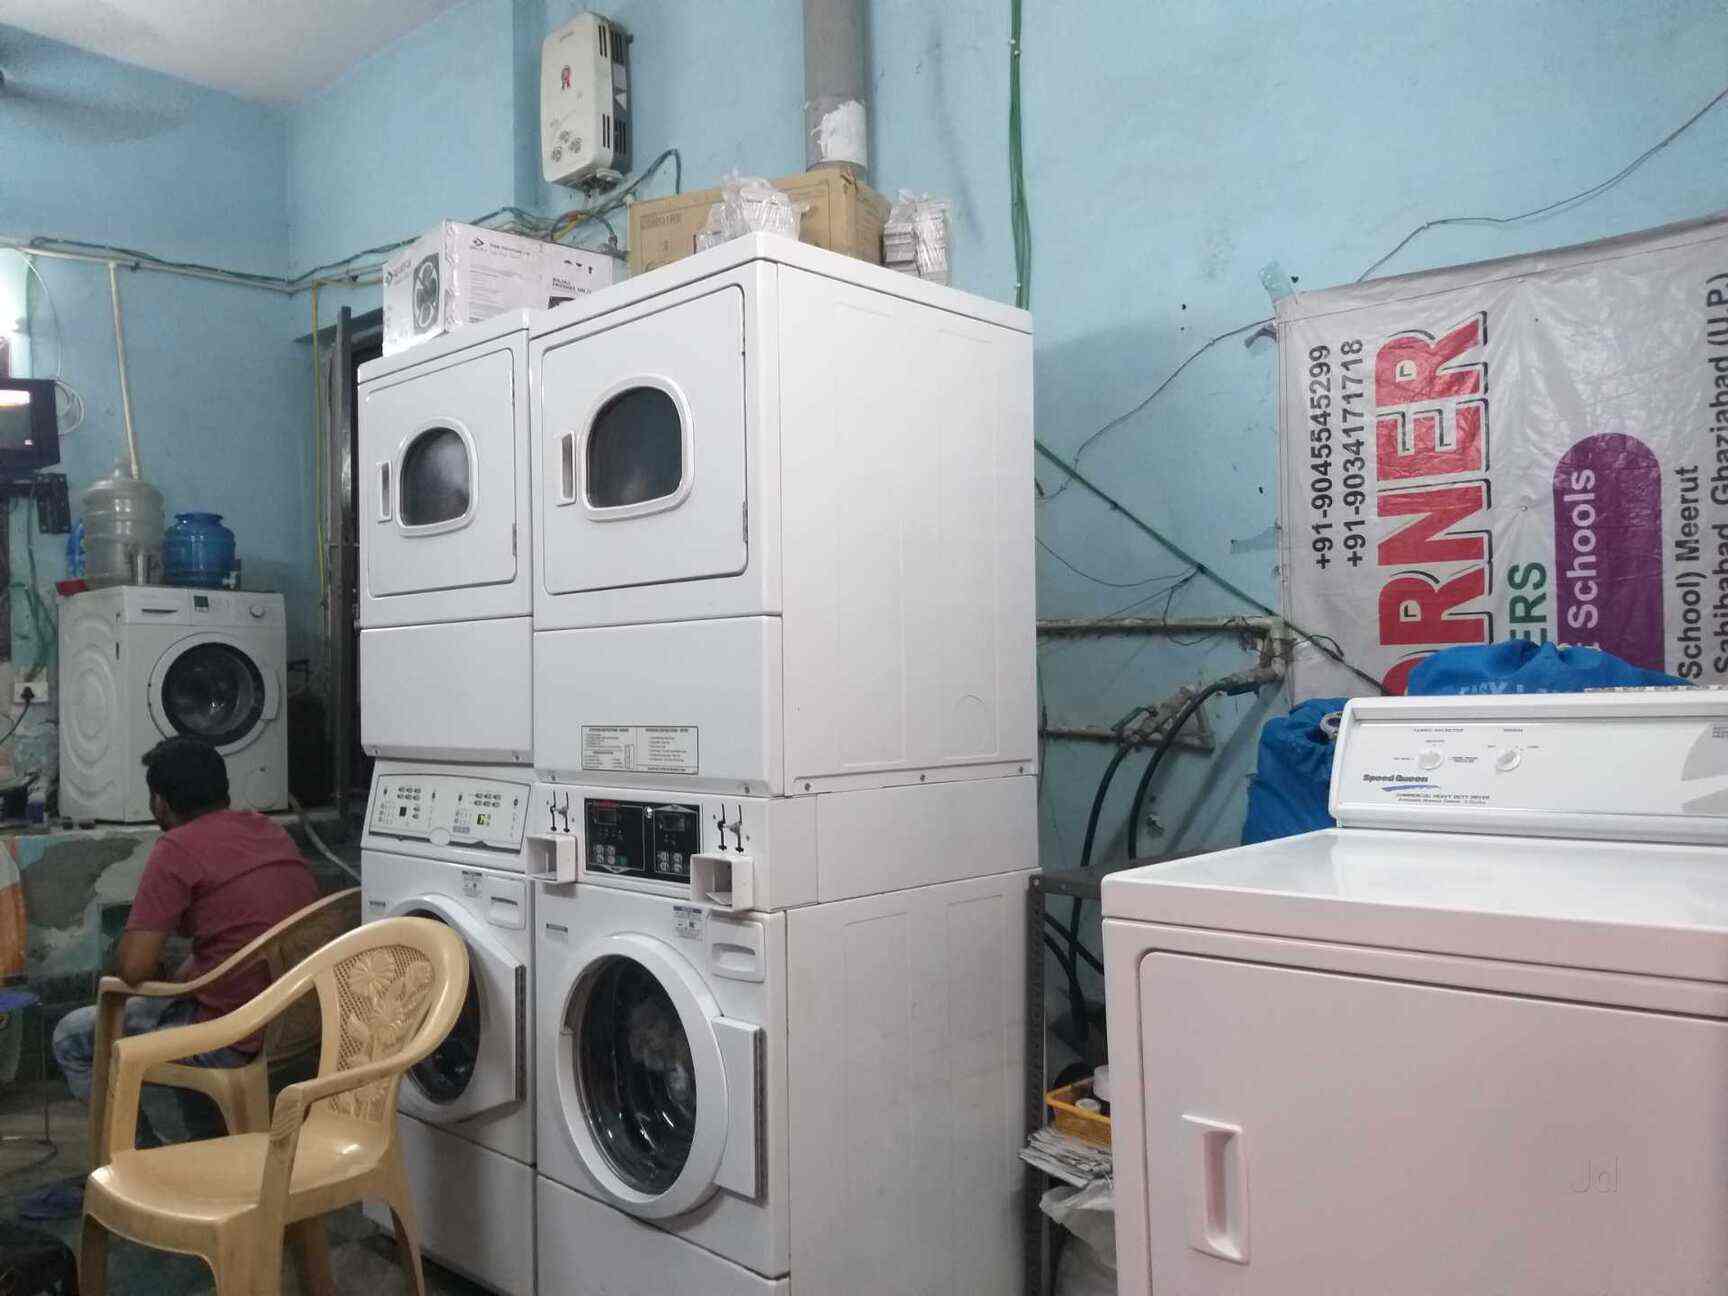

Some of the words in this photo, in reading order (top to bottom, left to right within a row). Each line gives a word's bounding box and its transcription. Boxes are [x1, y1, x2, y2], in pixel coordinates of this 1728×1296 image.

[1309, 345, 1333, 569] +91-9045545299
[1341, 339, 1367, 568] +91-9034171718
[1674, 464, 1700, 562] Meerut
[1565, 467, 1598, 629] Schools
[1676, 571, 1707, 680] School)
[1362, 773, 1395, 783] Speed
[1395, 774, 1429, 783] Queen
